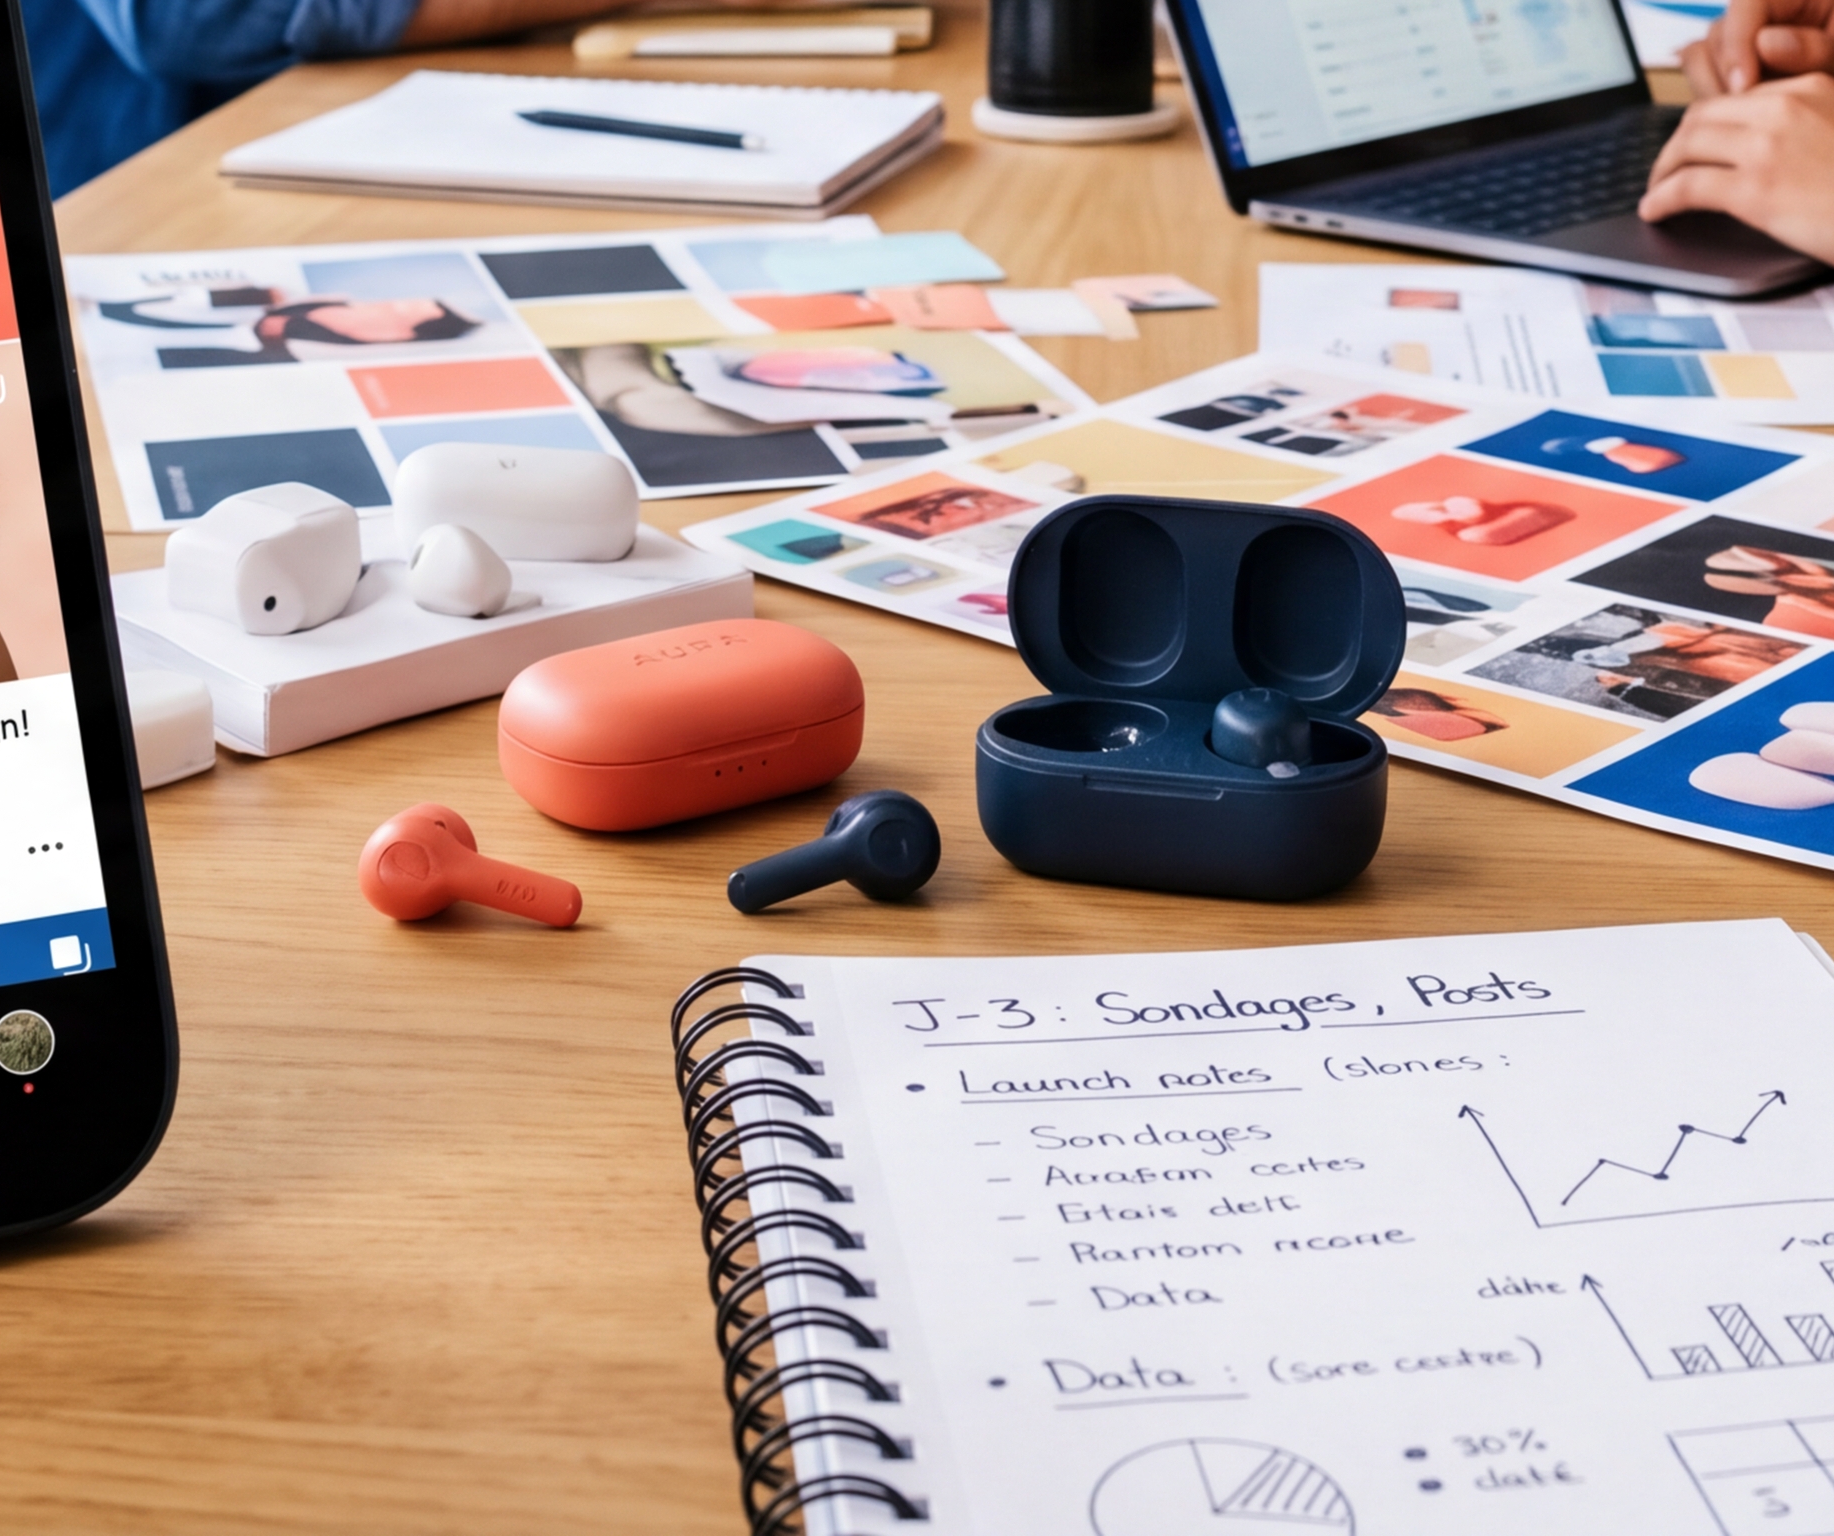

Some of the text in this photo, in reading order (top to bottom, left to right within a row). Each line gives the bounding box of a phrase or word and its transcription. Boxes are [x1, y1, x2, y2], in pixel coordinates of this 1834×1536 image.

[1406, 972, 1552, 1006] Posts
[959, 1070, 1131, 1093] Launch
[1030, 1123, 1273, 1156] Sondages
[1091, 1282, 1223, 1310] Data
[1043, 1356, 1196, 1394] Data
